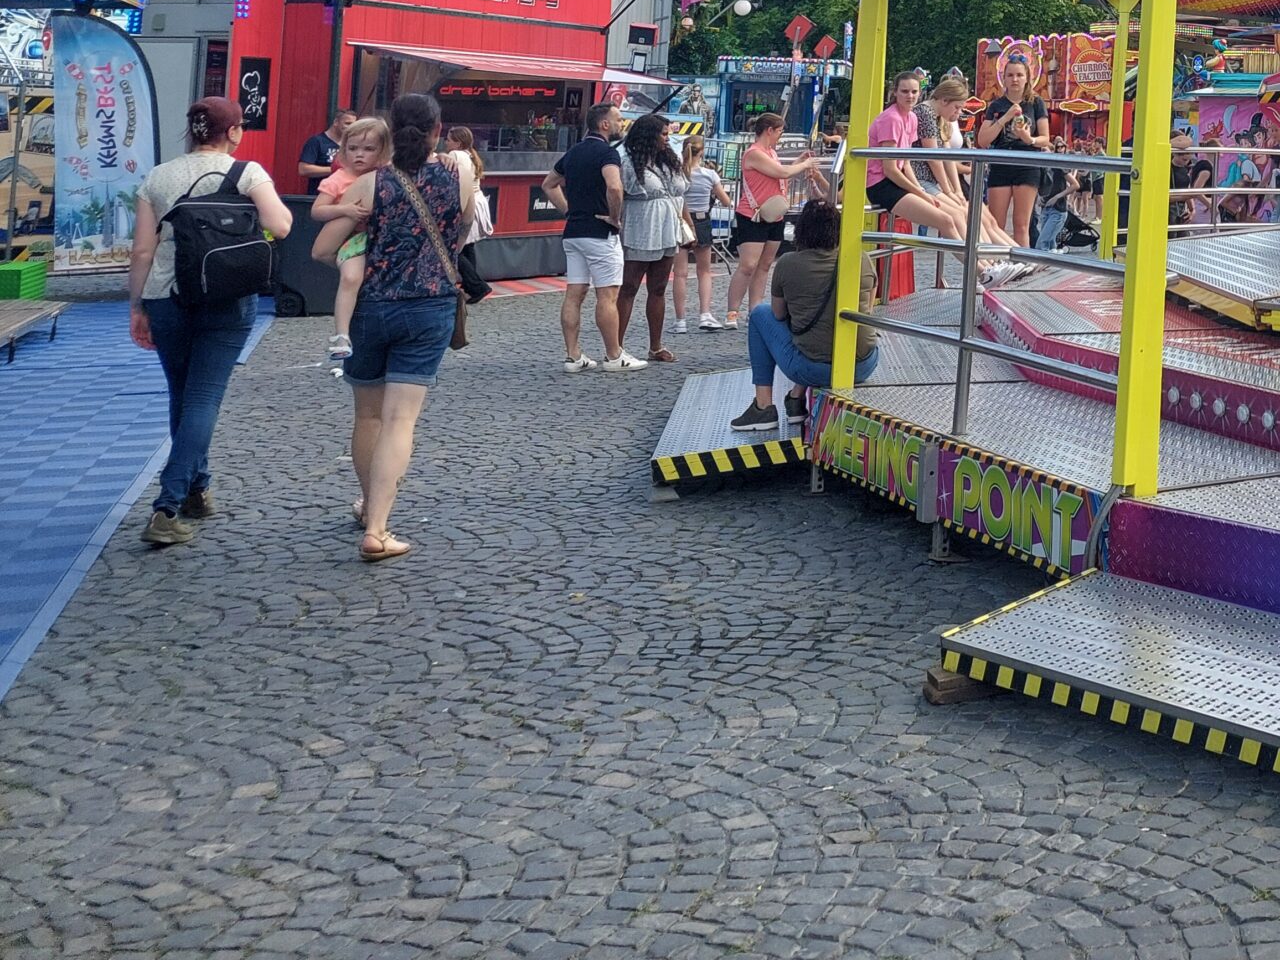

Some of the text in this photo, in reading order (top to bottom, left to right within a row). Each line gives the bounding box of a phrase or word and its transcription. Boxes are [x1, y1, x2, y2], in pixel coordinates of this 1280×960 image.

[1072, 62, 1108, 73] CHURROS
[1078, 71, 1111, 81] FACTORY
[439, 84, 556, 97] dre's bakery
[819, 407, 1084, 573] MEETING POINT
